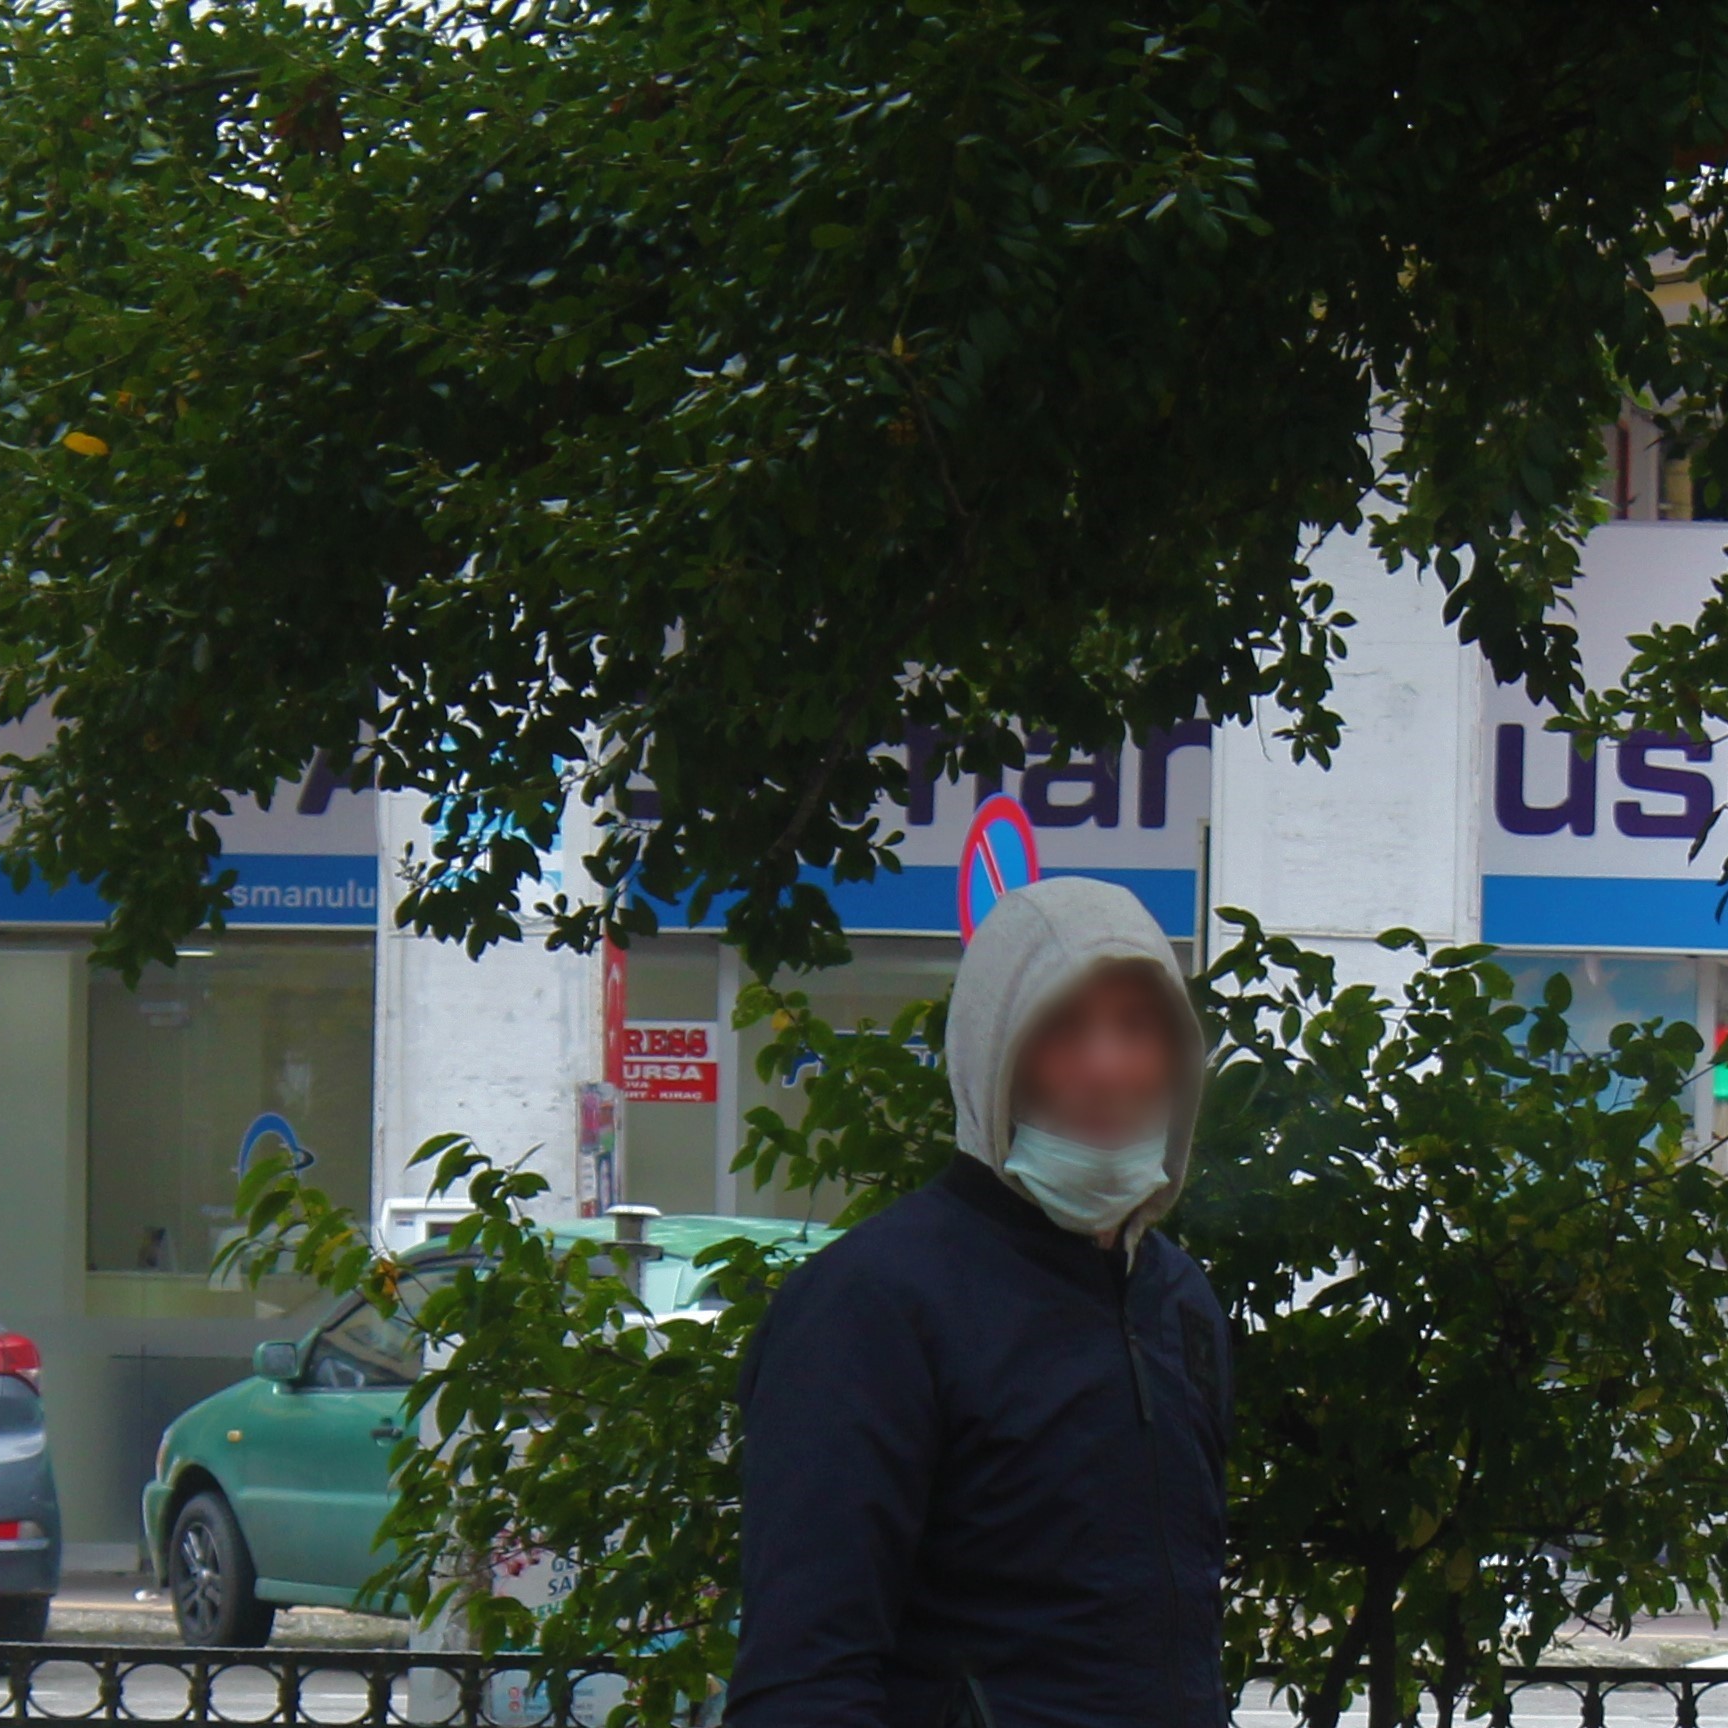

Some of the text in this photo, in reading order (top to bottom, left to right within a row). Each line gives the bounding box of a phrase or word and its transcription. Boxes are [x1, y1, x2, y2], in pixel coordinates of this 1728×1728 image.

[231, 879, 377, 908] smanulu
[623, 1028, 708, 1058] RESS
[623, 1064, 702, 1081] URSA
